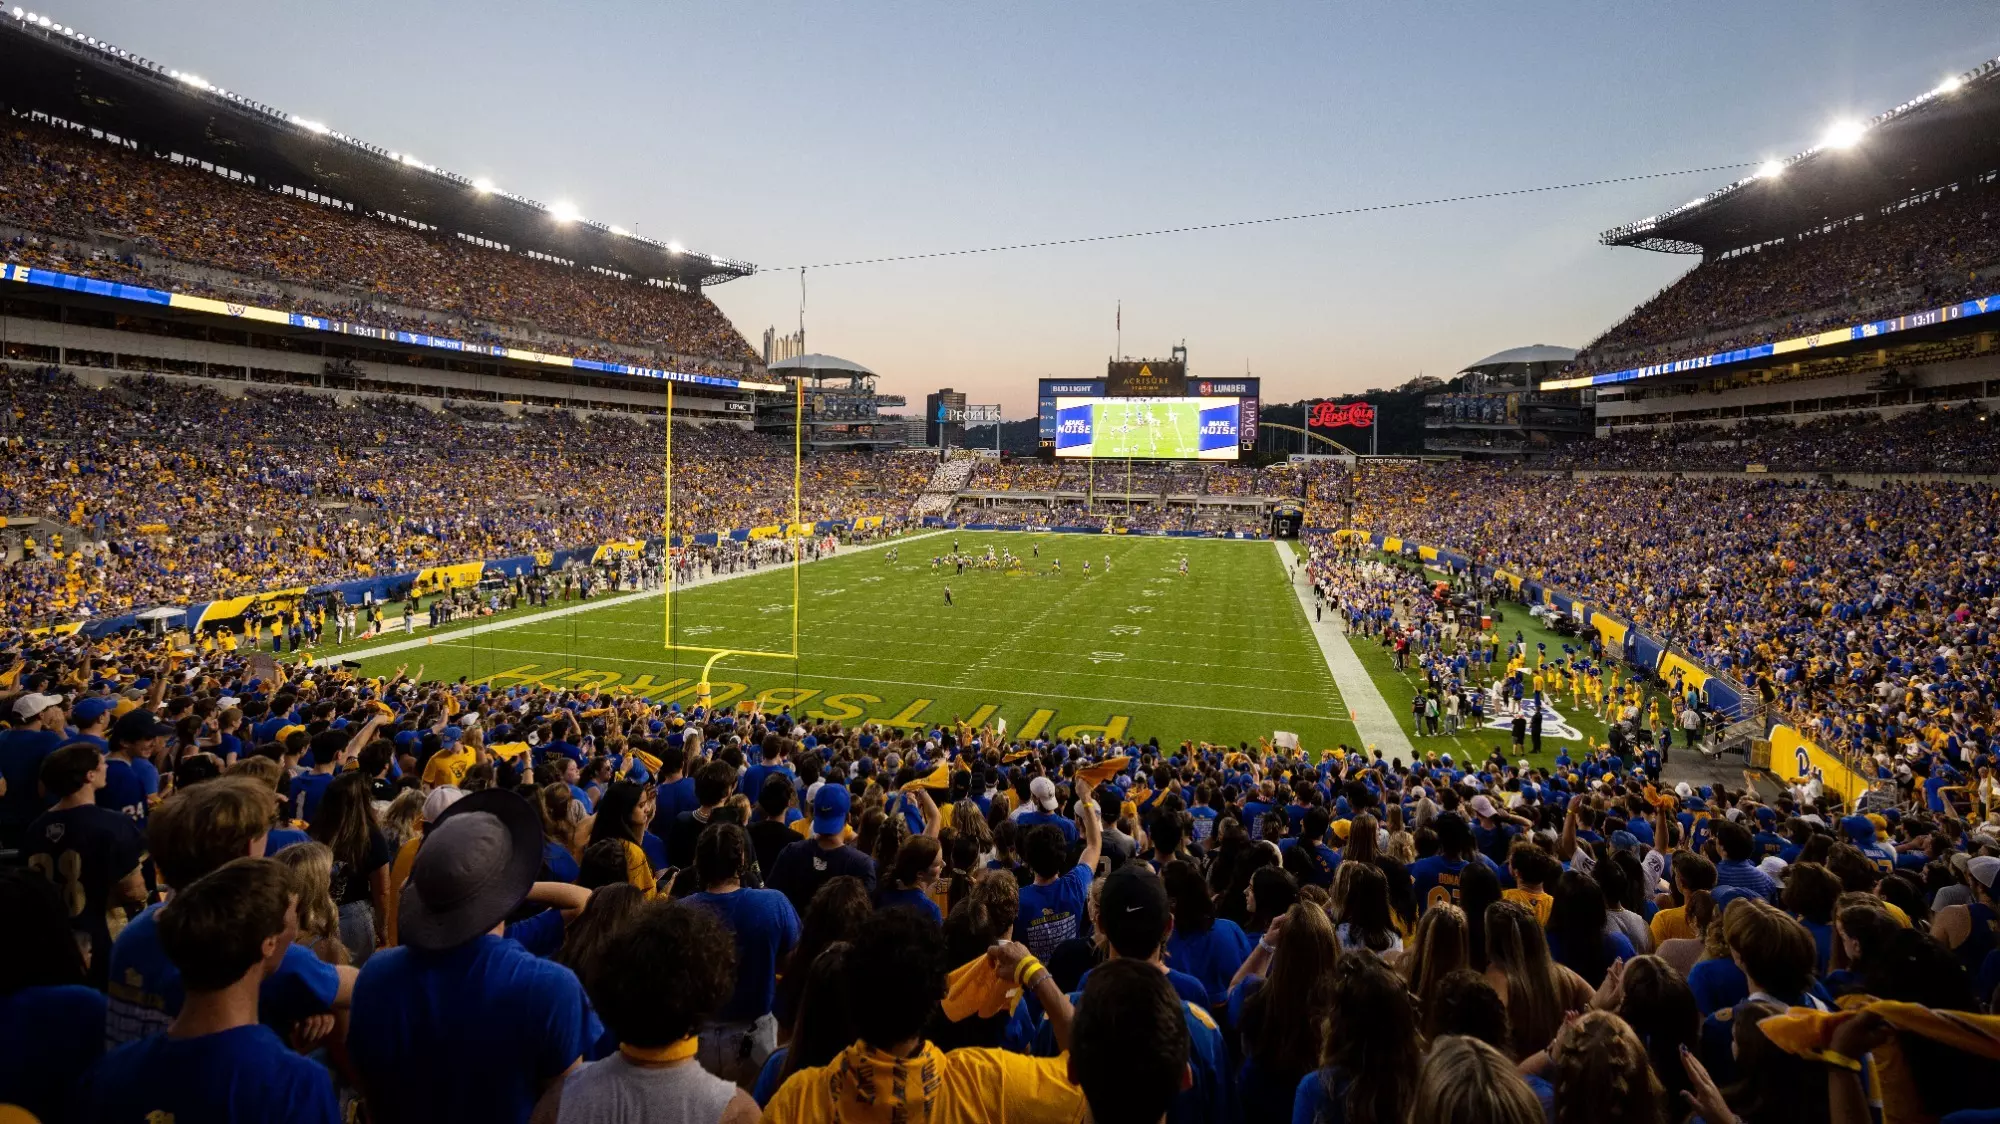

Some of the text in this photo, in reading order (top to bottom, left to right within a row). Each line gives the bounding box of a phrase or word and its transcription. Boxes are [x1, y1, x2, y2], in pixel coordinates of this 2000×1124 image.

[1891, 322, 1896, 331] 3
[1913, 312, 1935, 326] 13:11
[1952, 307, 1957, 318] 0
[334, 323, 339, 331] 3
[355, 327, 376, 338] 13:11
[390, 332, 396, 340] 0
[627, 366, 696, 383] MAKE NOISE
[1638, 355, 1713, 378] MAKE NOISE
[1214, 384, 1246, 393] LUMBER
[1245, 400, 1256, 437] UPMC
[1057, 425, 1092, 434] NOISE
[1200, 426, 1237, 435] NOISE
